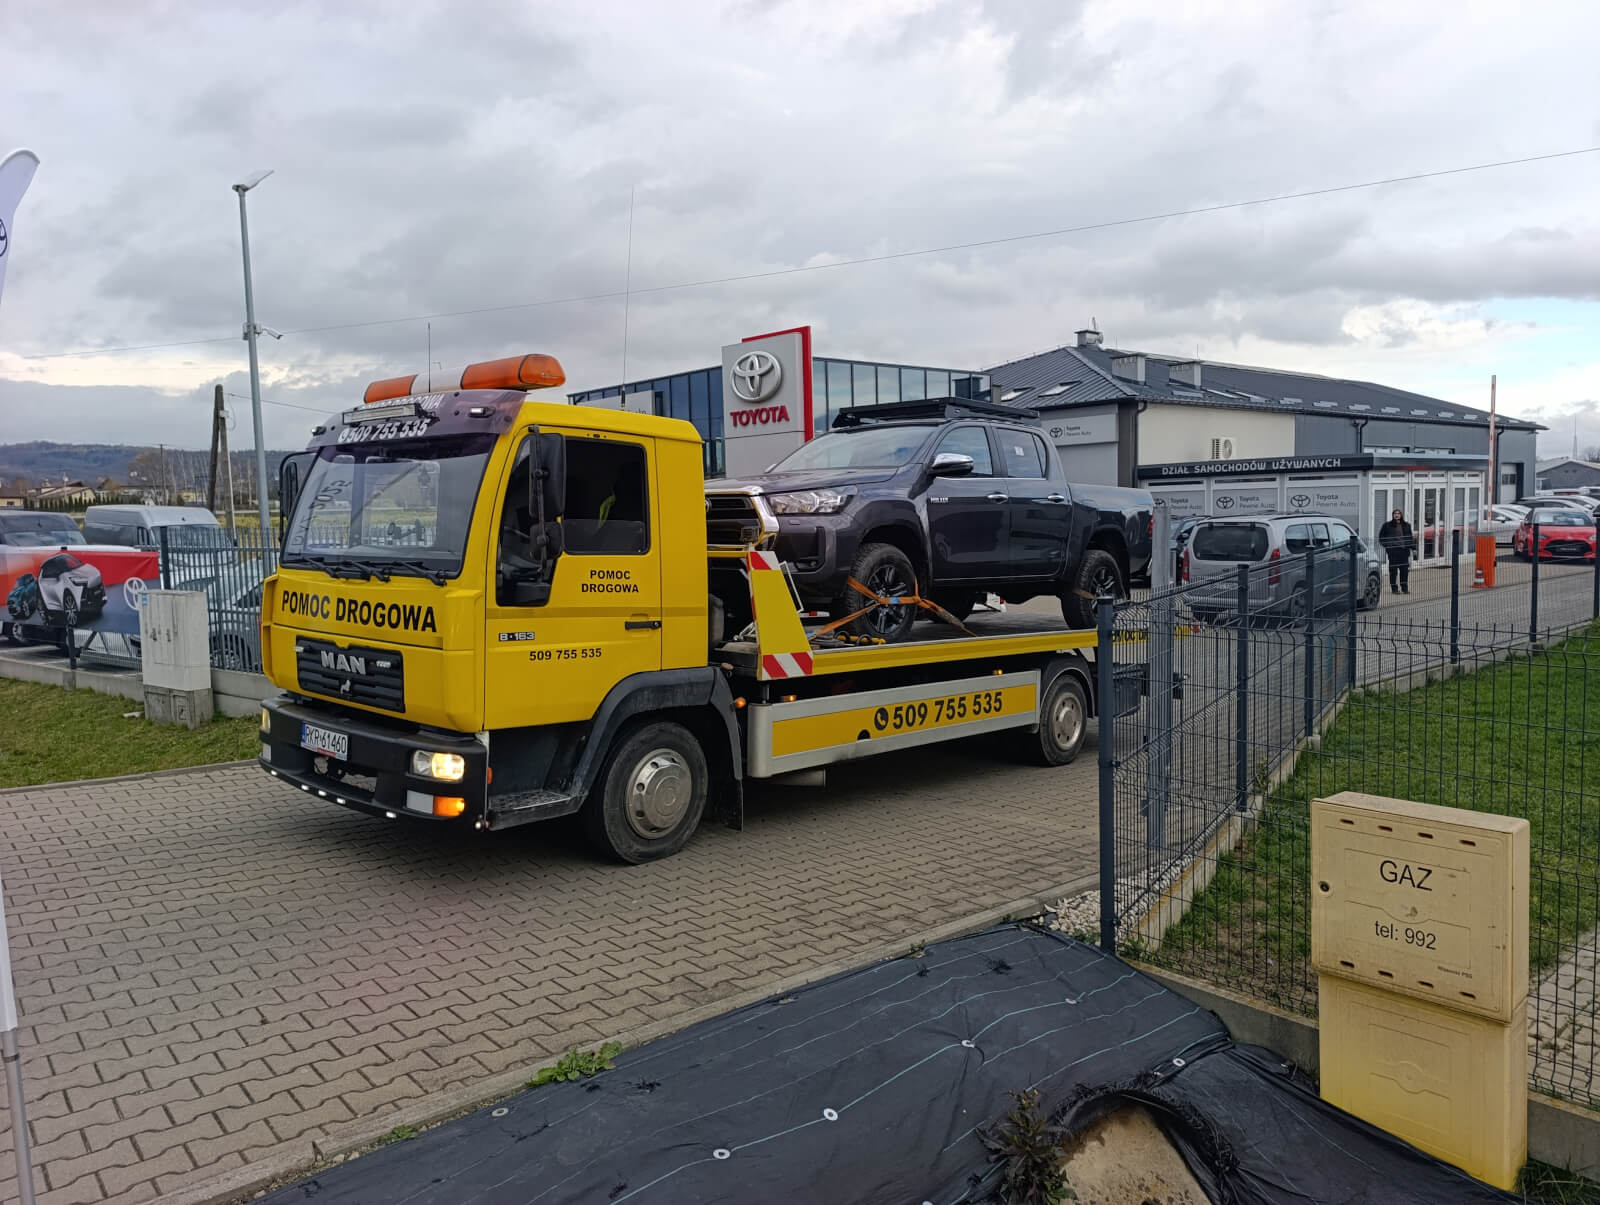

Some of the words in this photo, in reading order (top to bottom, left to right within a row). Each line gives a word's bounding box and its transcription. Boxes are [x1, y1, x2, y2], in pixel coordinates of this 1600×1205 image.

[730, 405, 790, 428] TOYOTA
[346, 426, 373, 443] 509
[371, 422, 400, 440] 755
[400, 418, 431, 438] 535
[1162, 466, 1190, 475] DZIAŁ
[1194, 461, 1266, 474] SAMOCHODÓW
[1272, 458, 1341, 470] UŻYWANYCH
[1315, 493, 1339, 502] Toyota
[590, 569, 631, 580] POMOC
[581, 583, 639, 593] DROGOWA
[281, 590, 331, 620] POMOC
[336, 597, 437, 633] DROGOWA
[321, 650, 367, 675] MAN
[529, 650, 552, 661] 509
[556, 649, 578, 660] 755
[581, 648, 602, 659] 535
[893, 702, 928, 729] 509
[934, 696, 967, 722] 755
[973, 691, 1003, 716] 535
[1380, 860, 1433, 891] GAZ
[1375, 920, 1399, 941] tel:
[1405, 927, 1437, 951] 992
